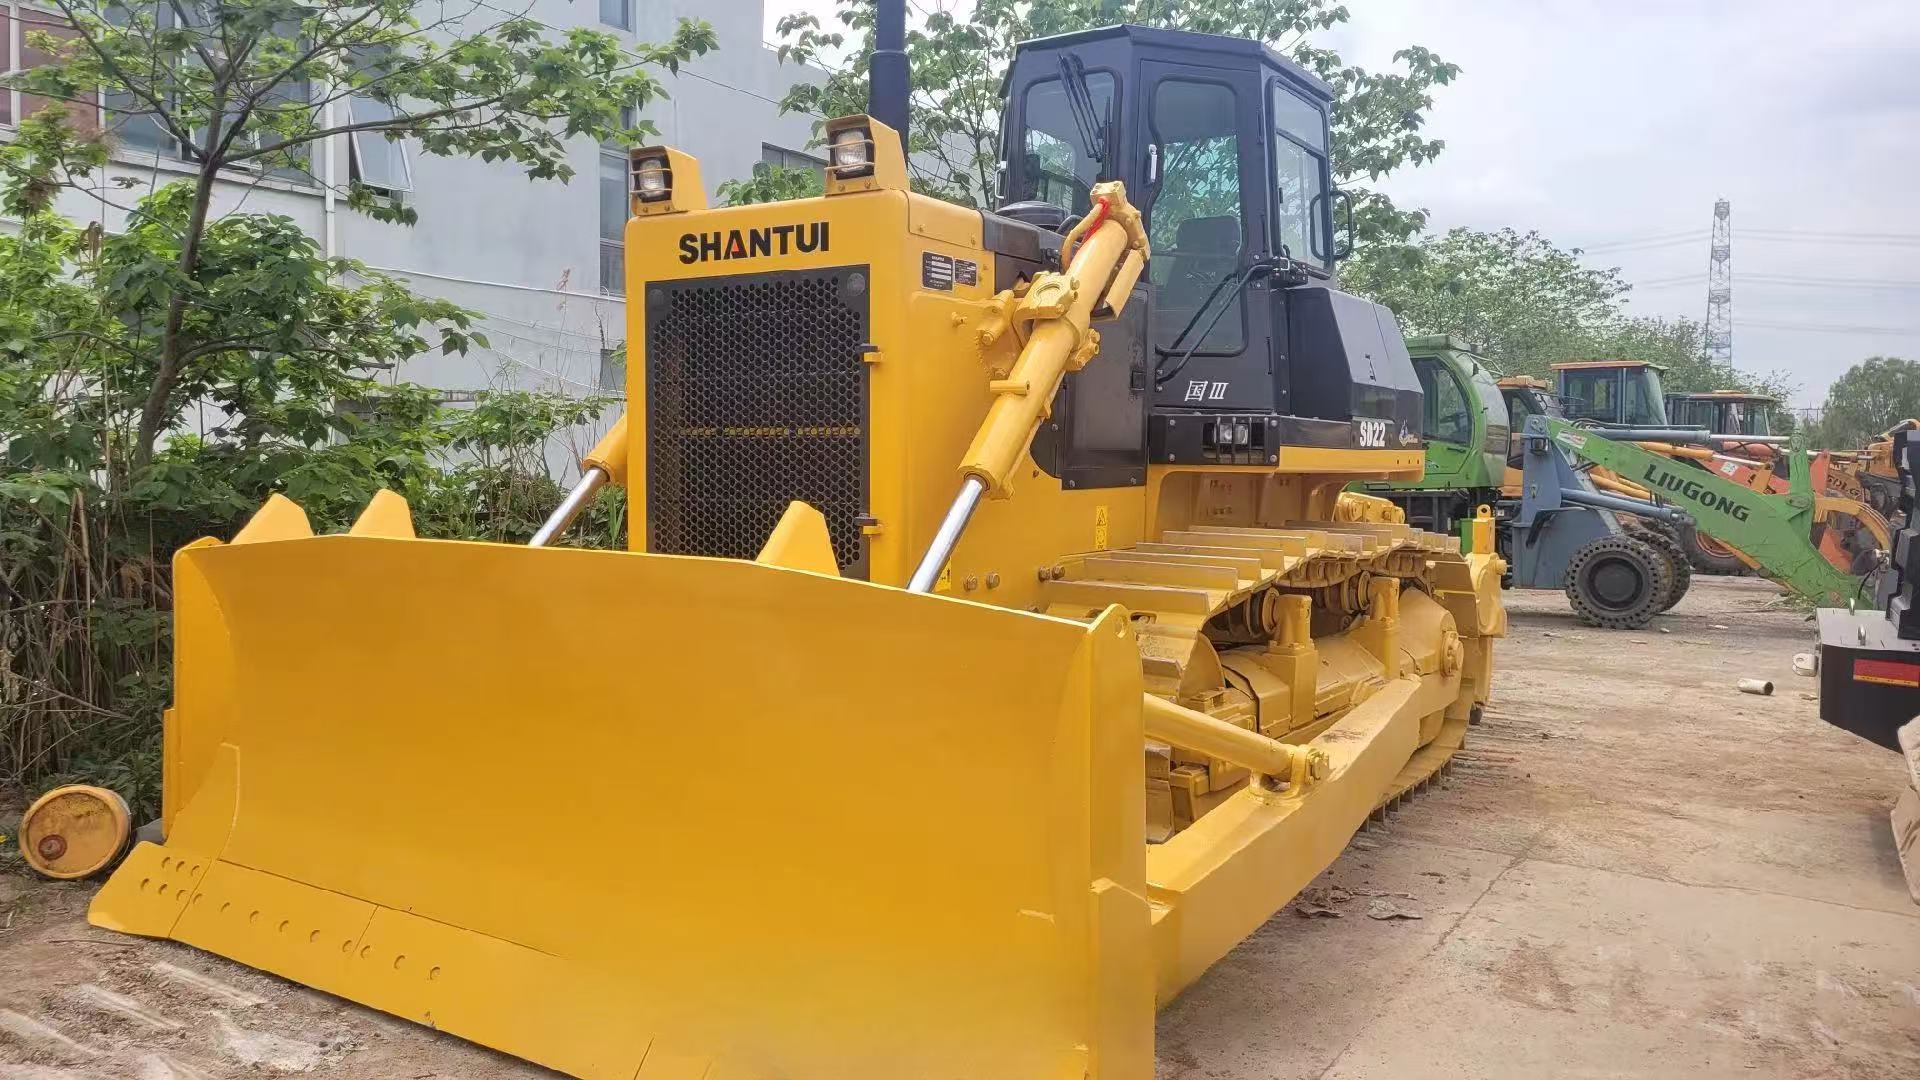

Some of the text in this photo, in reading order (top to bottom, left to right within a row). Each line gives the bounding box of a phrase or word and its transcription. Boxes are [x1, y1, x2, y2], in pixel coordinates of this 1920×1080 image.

[679, 221, 829, 264] SHANTUI
[1360, 420, 1385, 447] SD22
[1643, 463, 1751, 522] LIUGONG
